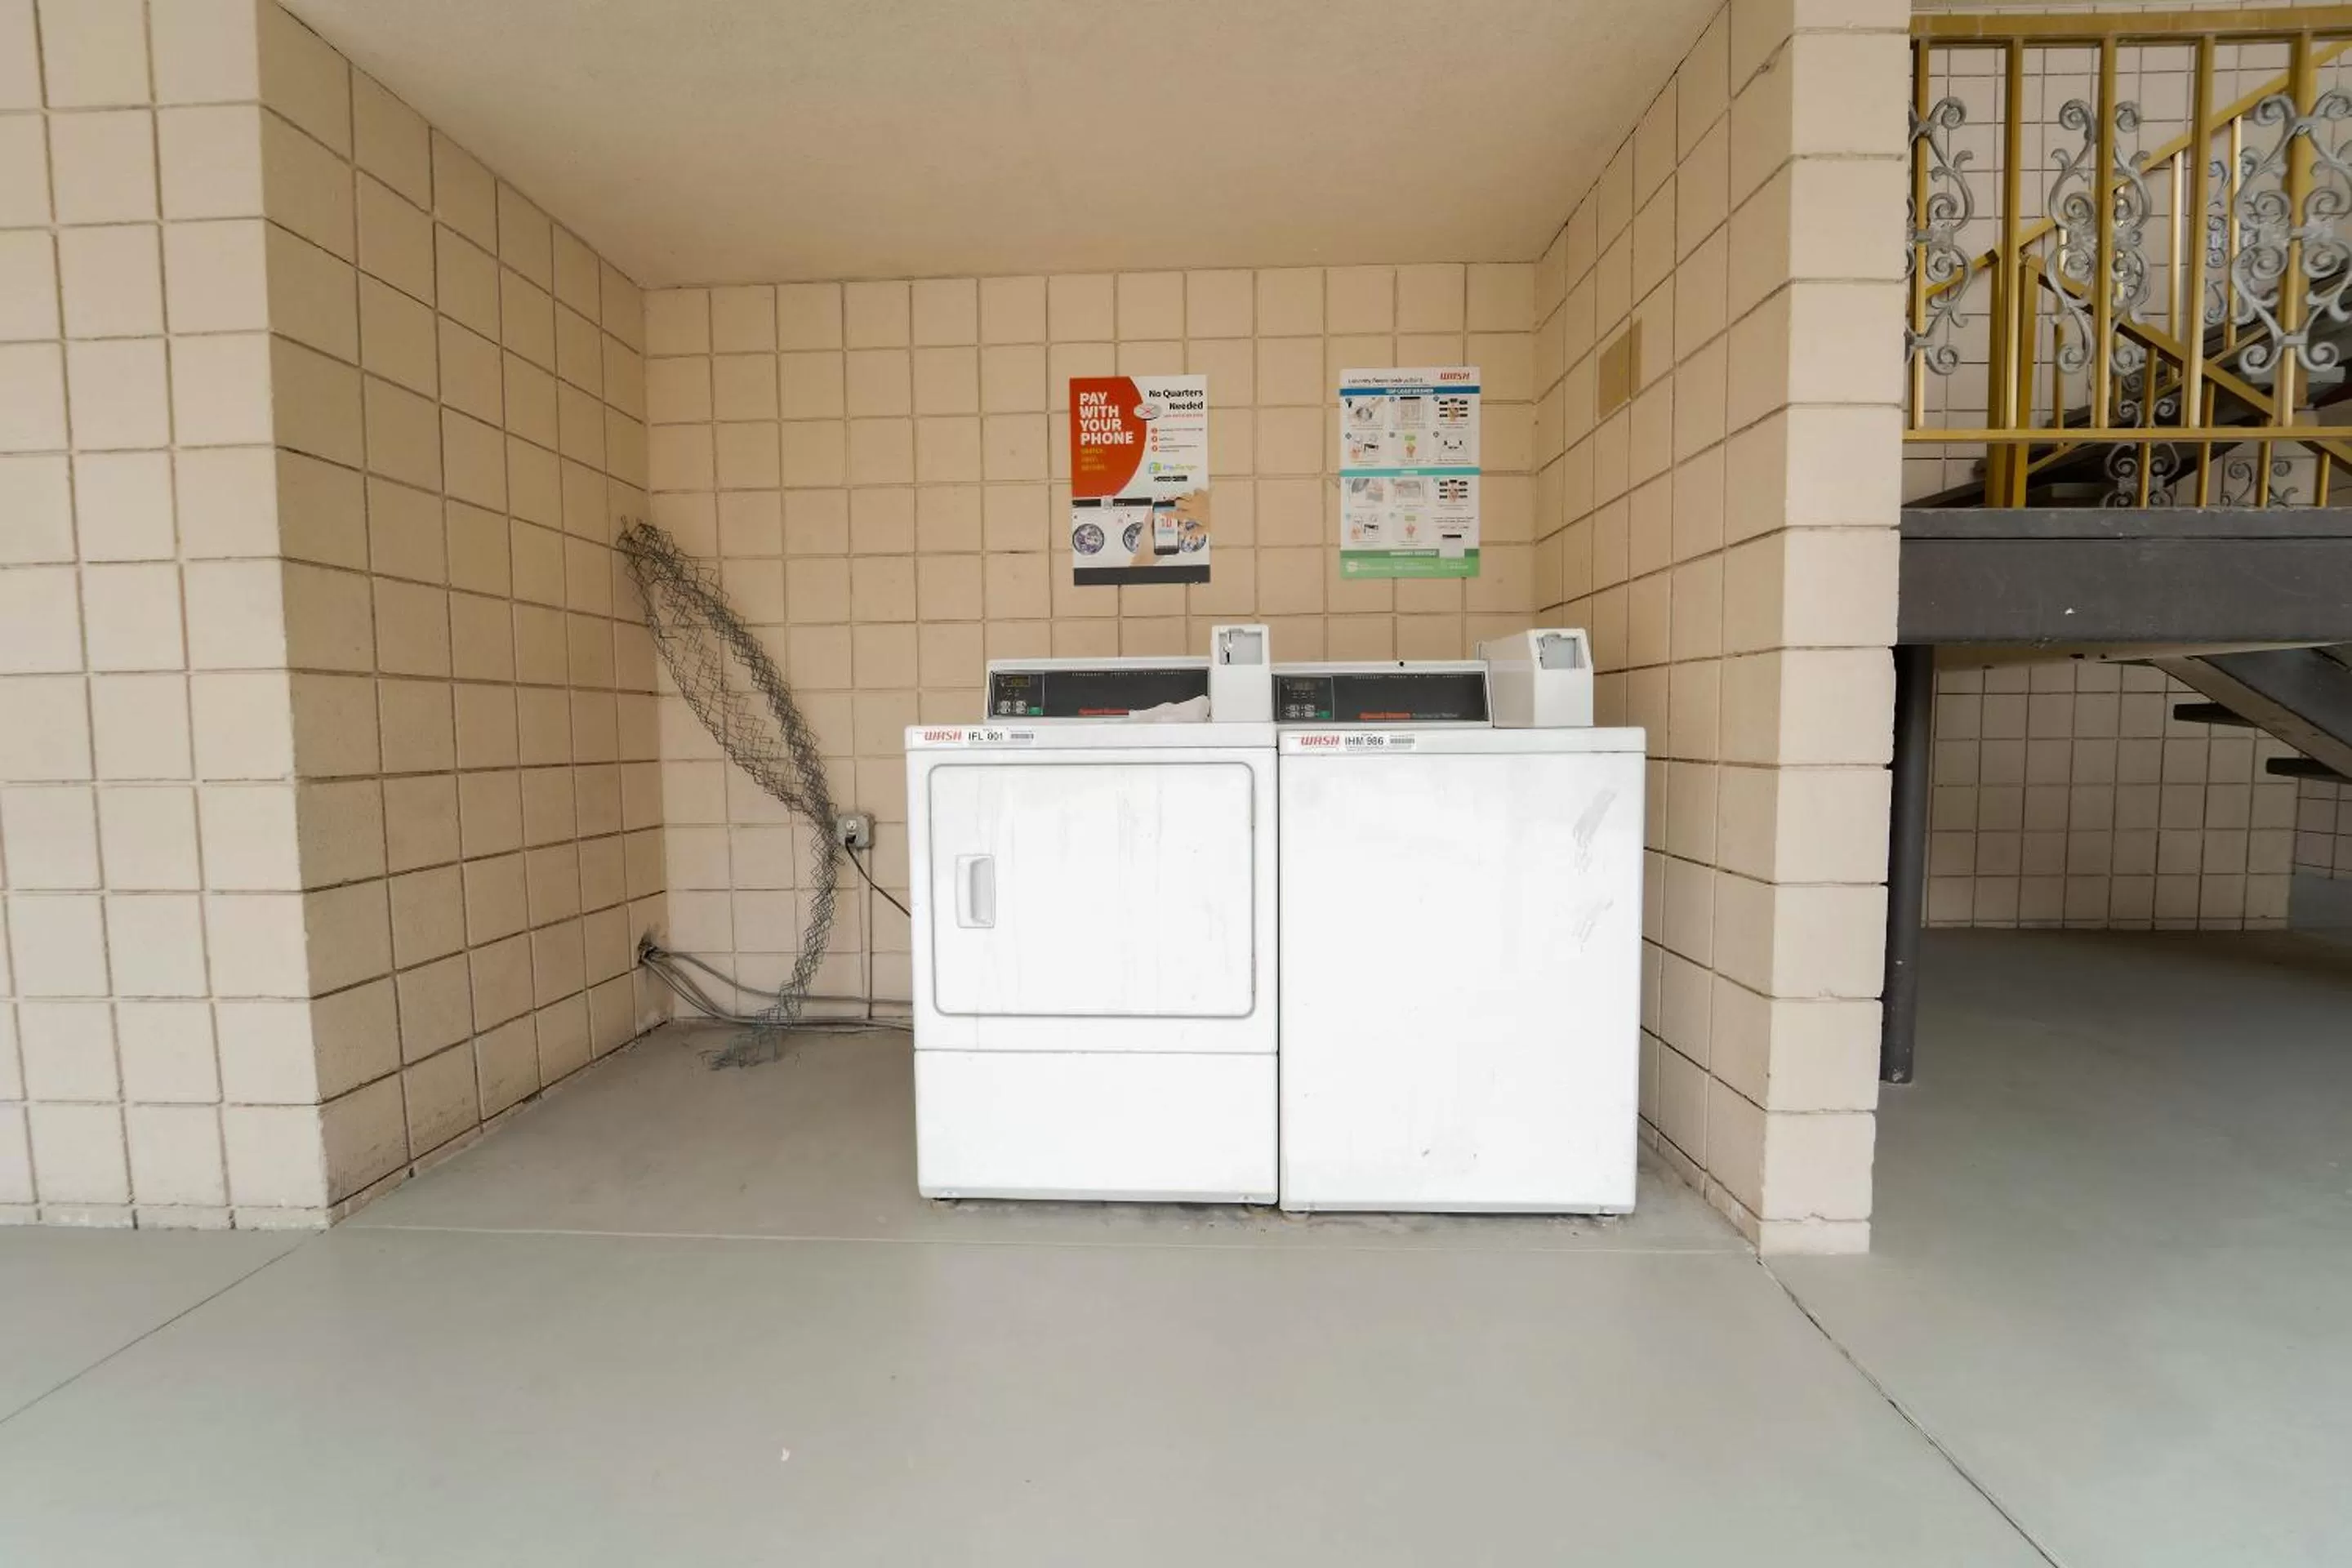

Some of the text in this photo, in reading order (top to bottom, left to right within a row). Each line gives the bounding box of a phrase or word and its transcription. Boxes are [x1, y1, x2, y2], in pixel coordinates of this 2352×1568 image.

[1440, 372, 1471, 380] WASH
[1080, 392, 1107, 405] PAY
[1163, 390, 1204, 399] Quarters
[1169, 401, 1204, 410] Needed
[1080, 405, 1119, 418] WITH
[1080, 418, 1122, 432] YOUR
[1080, 431, 1134, 445] PHONE
[924, 731, 962, 741] WASH
[968, 731, 984, 741] IFL
[1300, 735, 1340, 746] WASH
[1345, 736, 1364, 746] IHM
